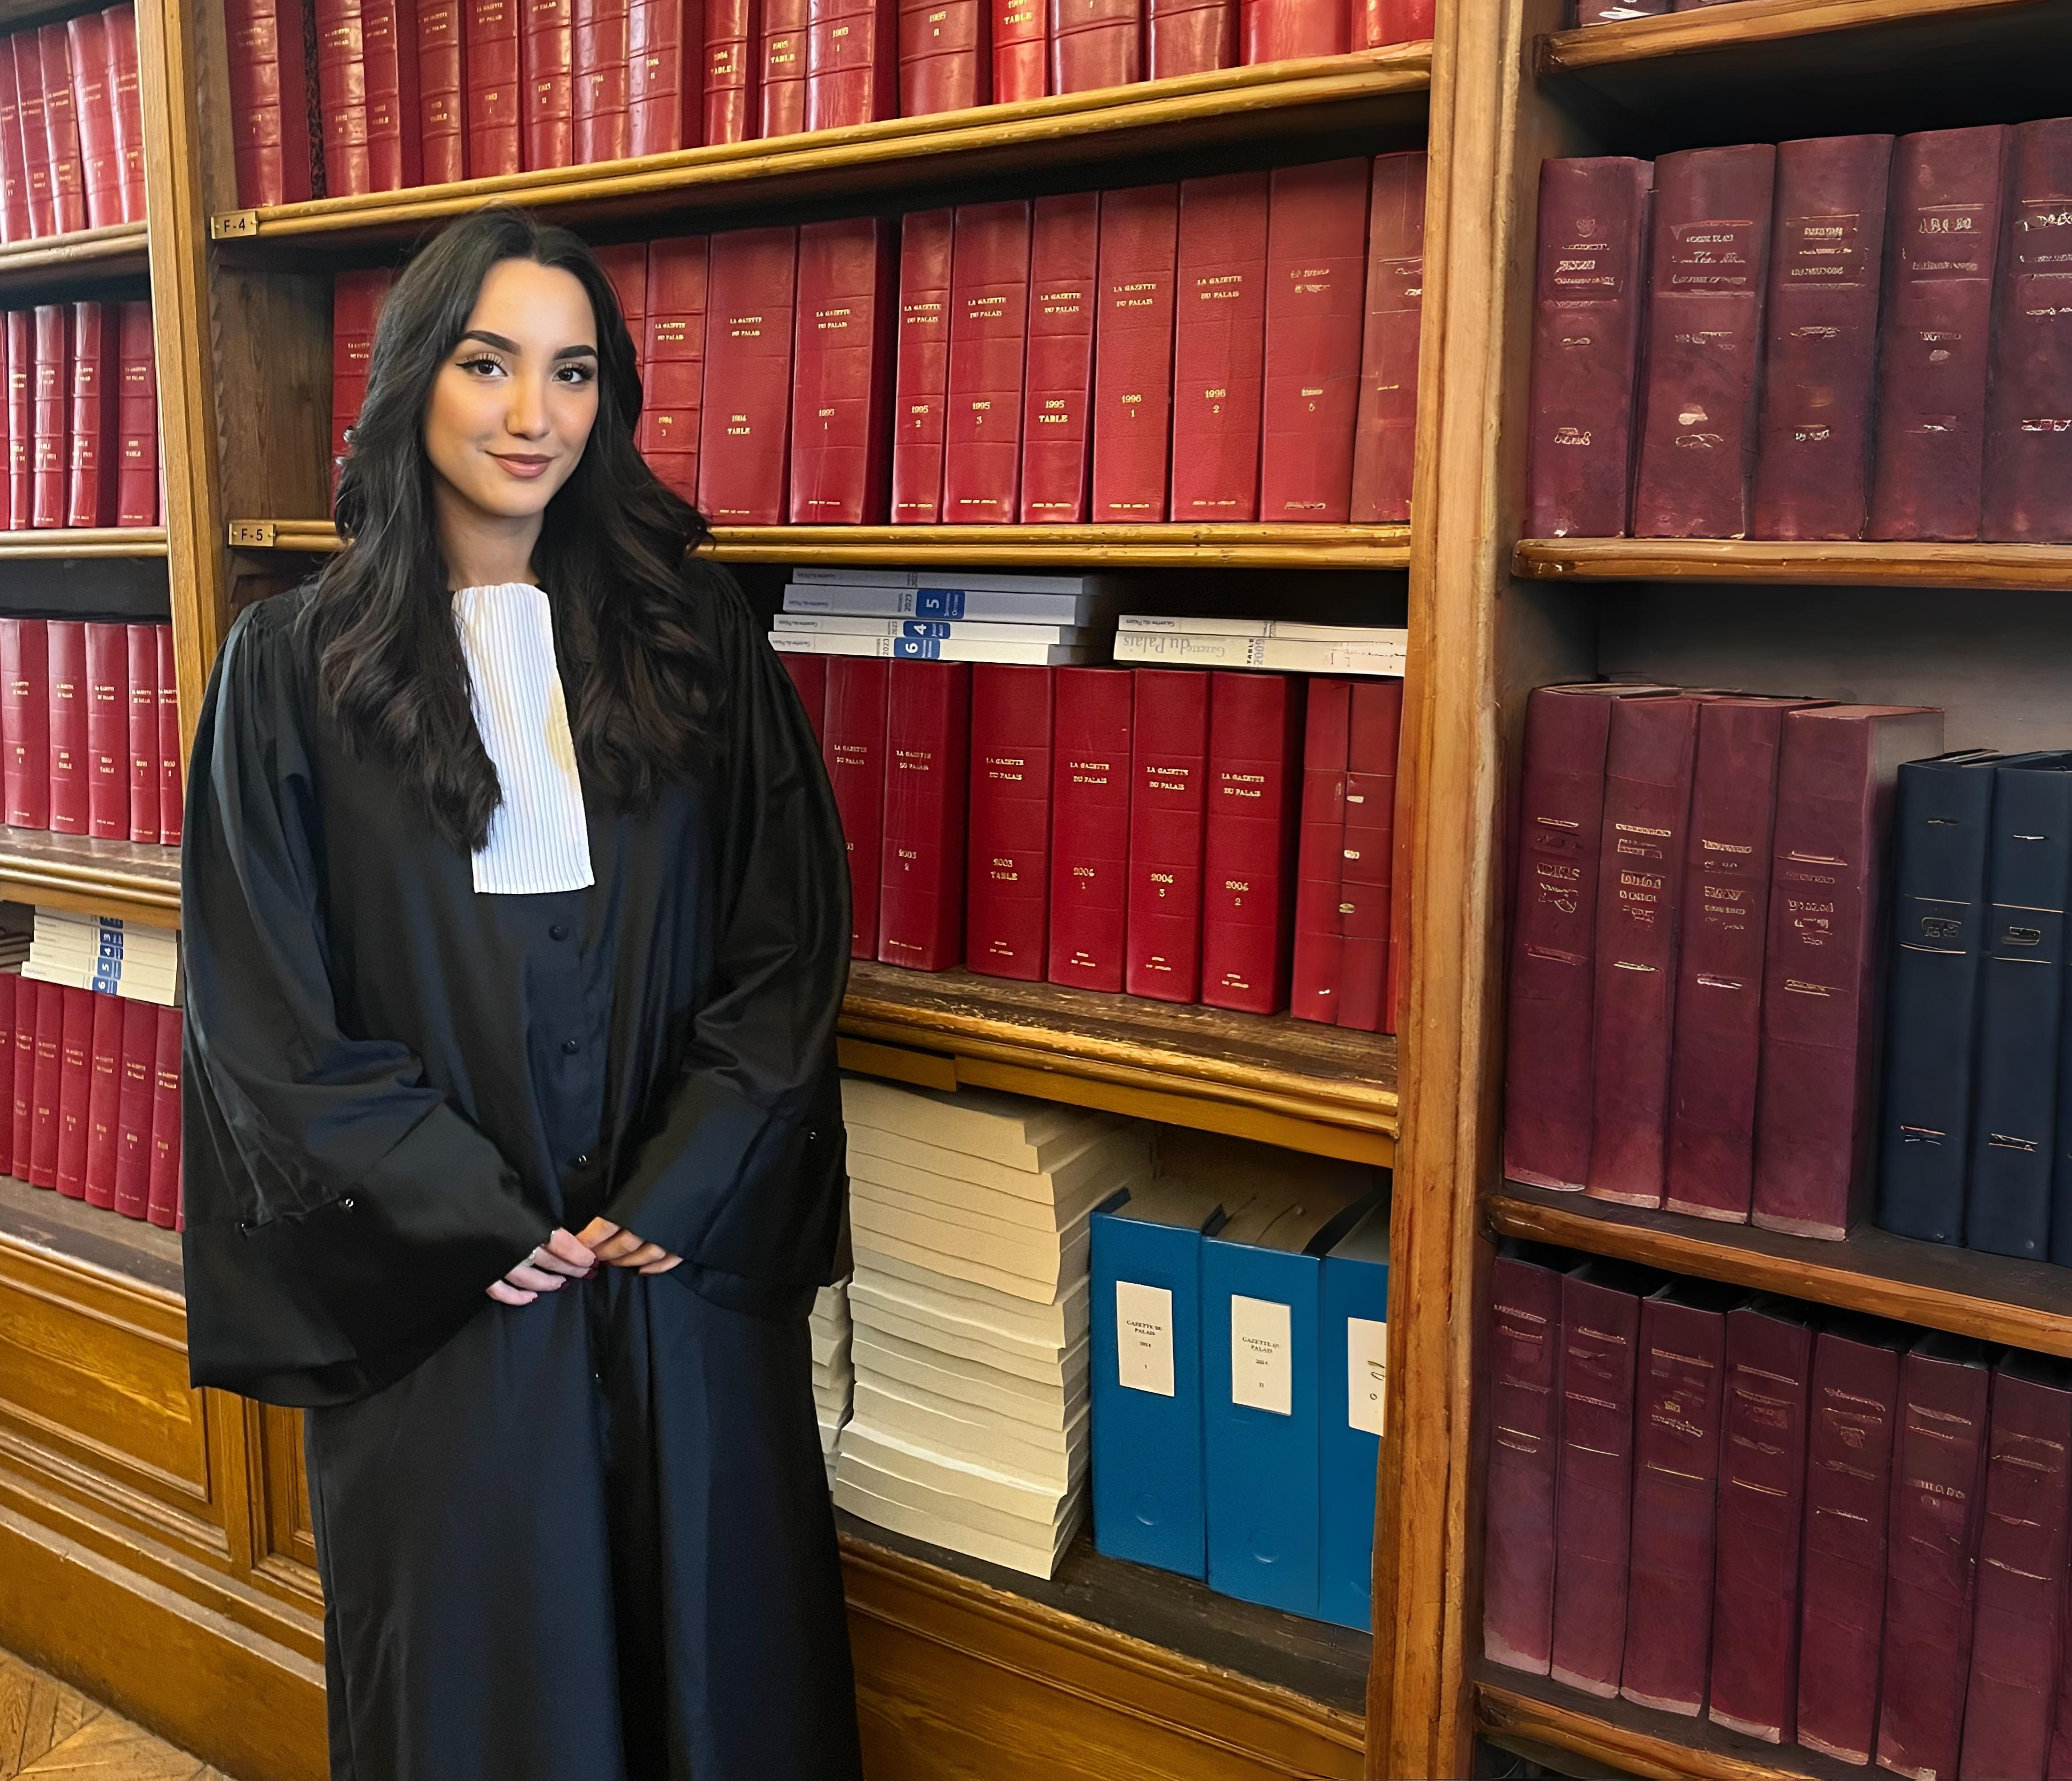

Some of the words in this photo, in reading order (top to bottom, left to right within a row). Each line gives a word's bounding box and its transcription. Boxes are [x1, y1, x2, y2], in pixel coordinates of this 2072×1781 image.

[1004, 12, 1032, 25] TABLE
[224, 218, 246, 232] F-4
[1209, 275, 1242, 284] GAZETTE
[1125, 283, 1156, 292] GAZETTE
[1205, 389, 1226, 398] 1996
[1121, 394, 1141, 404] 1996
[972, 402, 991, 410] 1995
[1045, 400, 1065, 409] 1995
[1213, 405, 1220, 413] 2
[1130, 409, 1135, 417] 1
[242, 528, 263, 541] F-5
[926, 599, 939, 609] 5
[914, 624, 927, 635] 4
[905, 643, 918, 653] 6
[1123, 635, 1165, 654] Palais
[1170, 638, 1190, 655] du
[1188, 644, 1225, 658] Gazette
[1254, 639, 1265, 666] 2009
[1233, 774, 1265, 783] GAZETTE
[1236, 788, 1261, 797] PALAIS
[991, 872, 1018, 881] TABLE
[1234, 897, 1241, 906] 2
[1126, 1320, 1153, 1329] GAZETTE
[1242, 1337, 1272, 1347] GAZETTE
